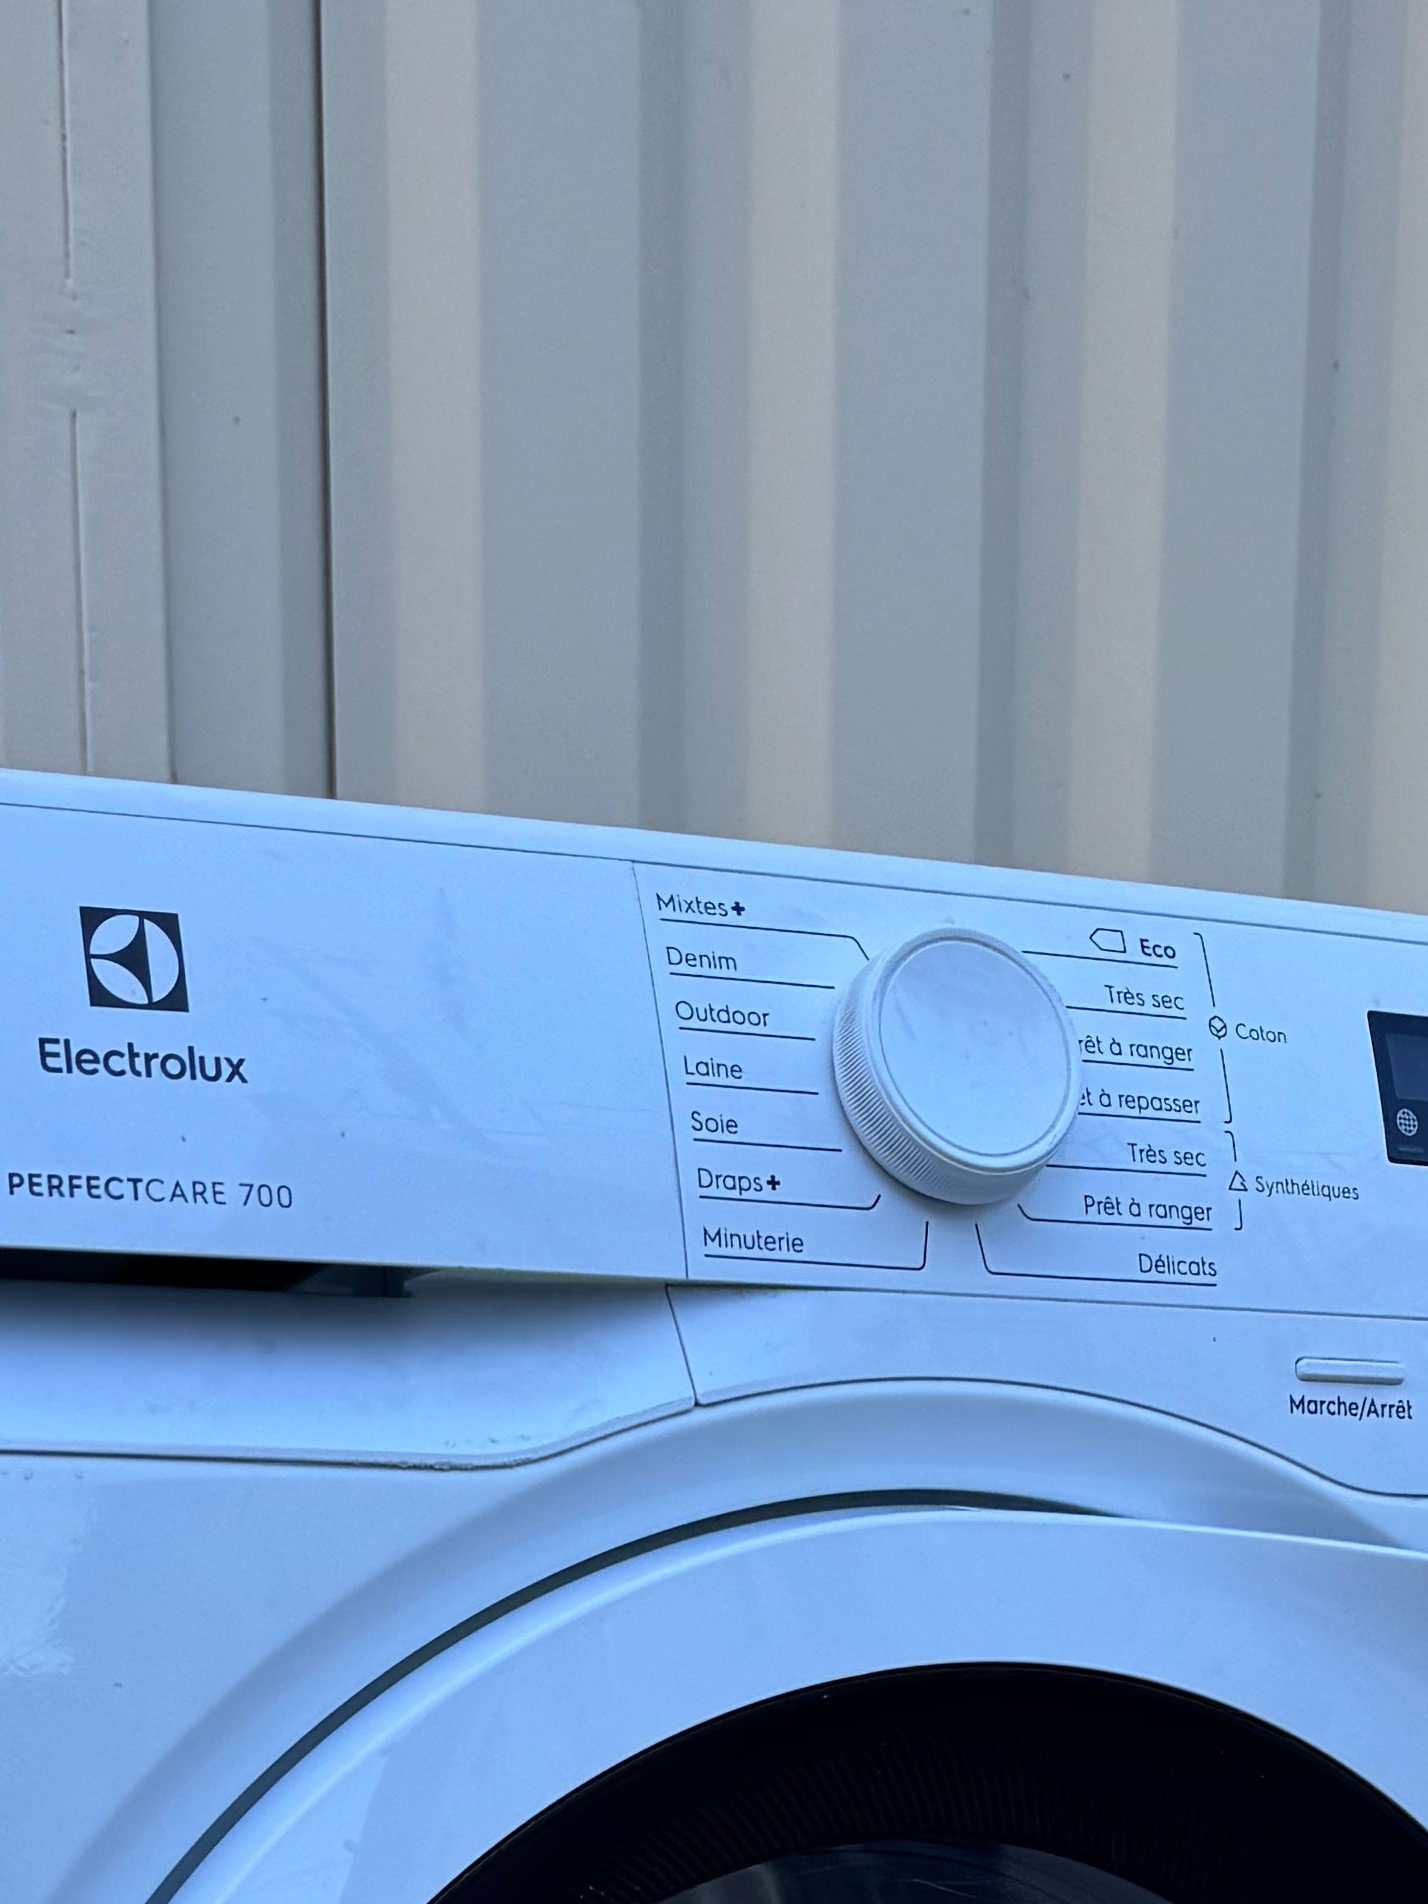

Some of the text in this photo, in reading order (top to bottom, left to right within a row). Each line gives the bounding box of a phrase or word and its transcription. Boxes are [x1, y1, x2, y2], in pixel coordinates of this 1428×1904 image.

[655, 892, 746, 917] Mixtes+
[666, 945, 738, 971] Denim
[1139, 938, 1177, 959] Eco
[1104, 984, 1185, 1011] Très sec
[675, 1000, 770, 1028] Outdoor
[1235, 1022, 1288, 1044] Coton
[38, 1036, 249, 1085] Electrolux
[1077, 1034, 1193, 1065] rêt à ranger
[683, 1055, 743, 1080] Laine
[1098, 1088, 1112, 1108] à
[1118, 1092, 1201, 1114] repasser
[690, 1110, 739, 1135] Soie
[1127, 1142, 1207, 1168] Très sec
[7, 1171, 293, 1209] PERFECTCARE 700
[697, 1167, 781, 1196] Draps+
[1254, 1175, 1360, 1202] Synthétiques
[1083, 1194, 1213, 1226] Prêt à ranger
[703, 1225, 805, 1254] Minuterie
[1138, 1252, 1218, 1277] Délicats
[1289, 1393, 1413, 1422] Marche/Arrêt
